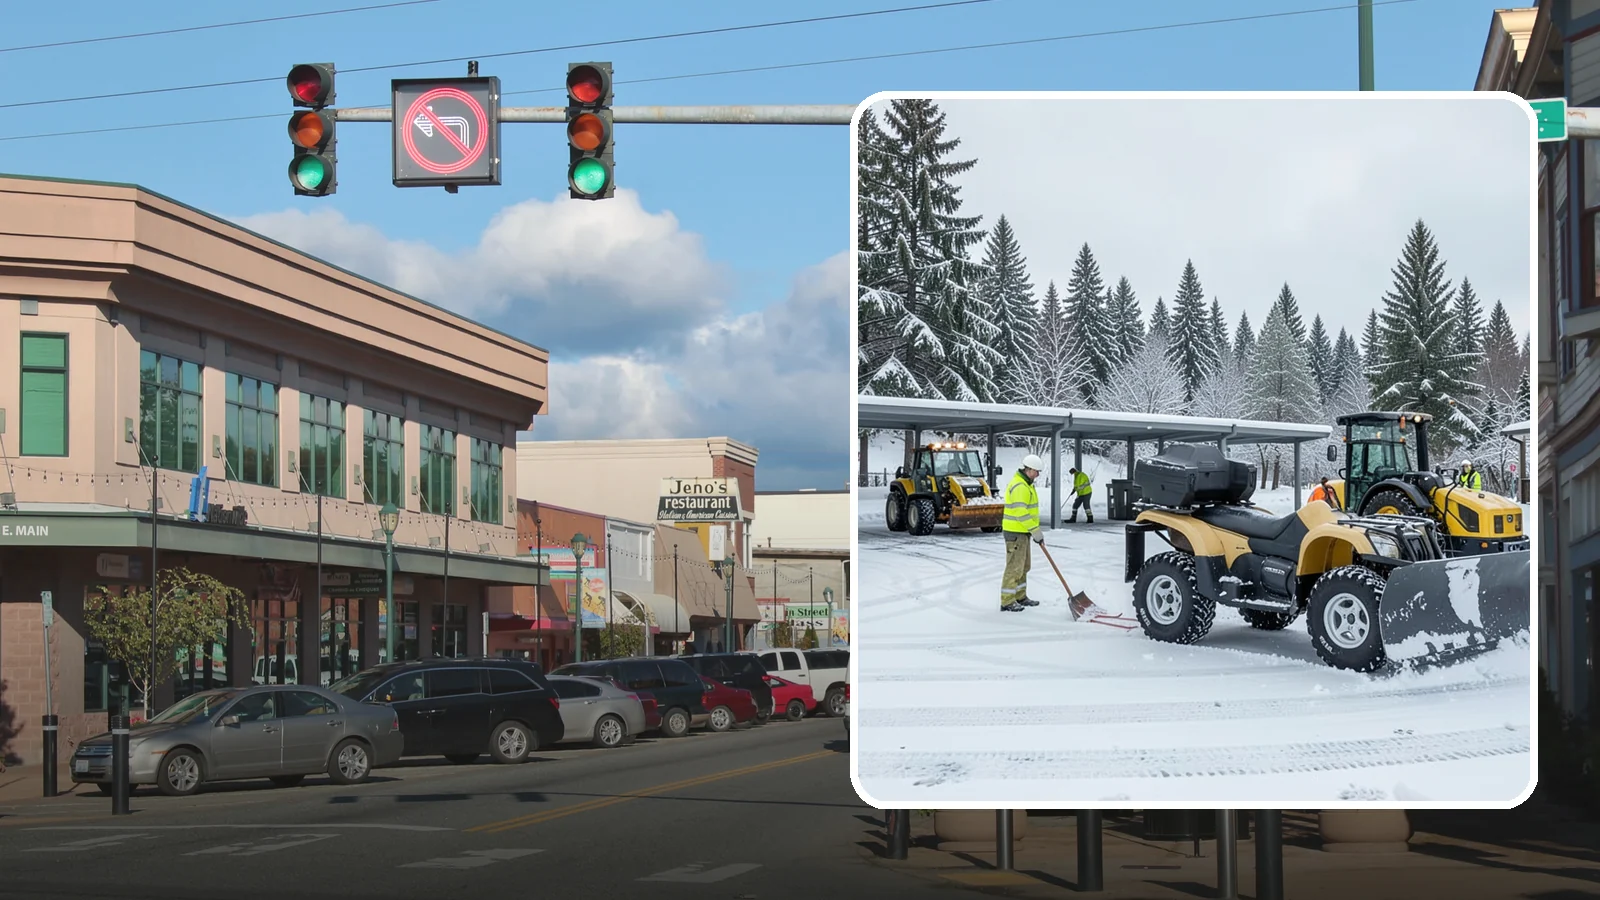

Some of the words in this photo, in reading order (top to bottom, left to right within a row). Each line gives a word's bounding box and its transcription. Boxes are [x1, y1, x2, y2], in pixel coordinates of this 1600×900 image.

[670, 480, 727, 494] Jeno's
[665, 496, 731, 509] restaurant
[658, 510, 681, 519] Italian
[686, 510, 714, 519] American
[715, 510, 737, 519] Cuisine
[2, 525, 13, 536] E.
[15, 525, 49, 536] MAIN
[797, 607, 828, 617] Street
[790, 619, 823, 627] lass
